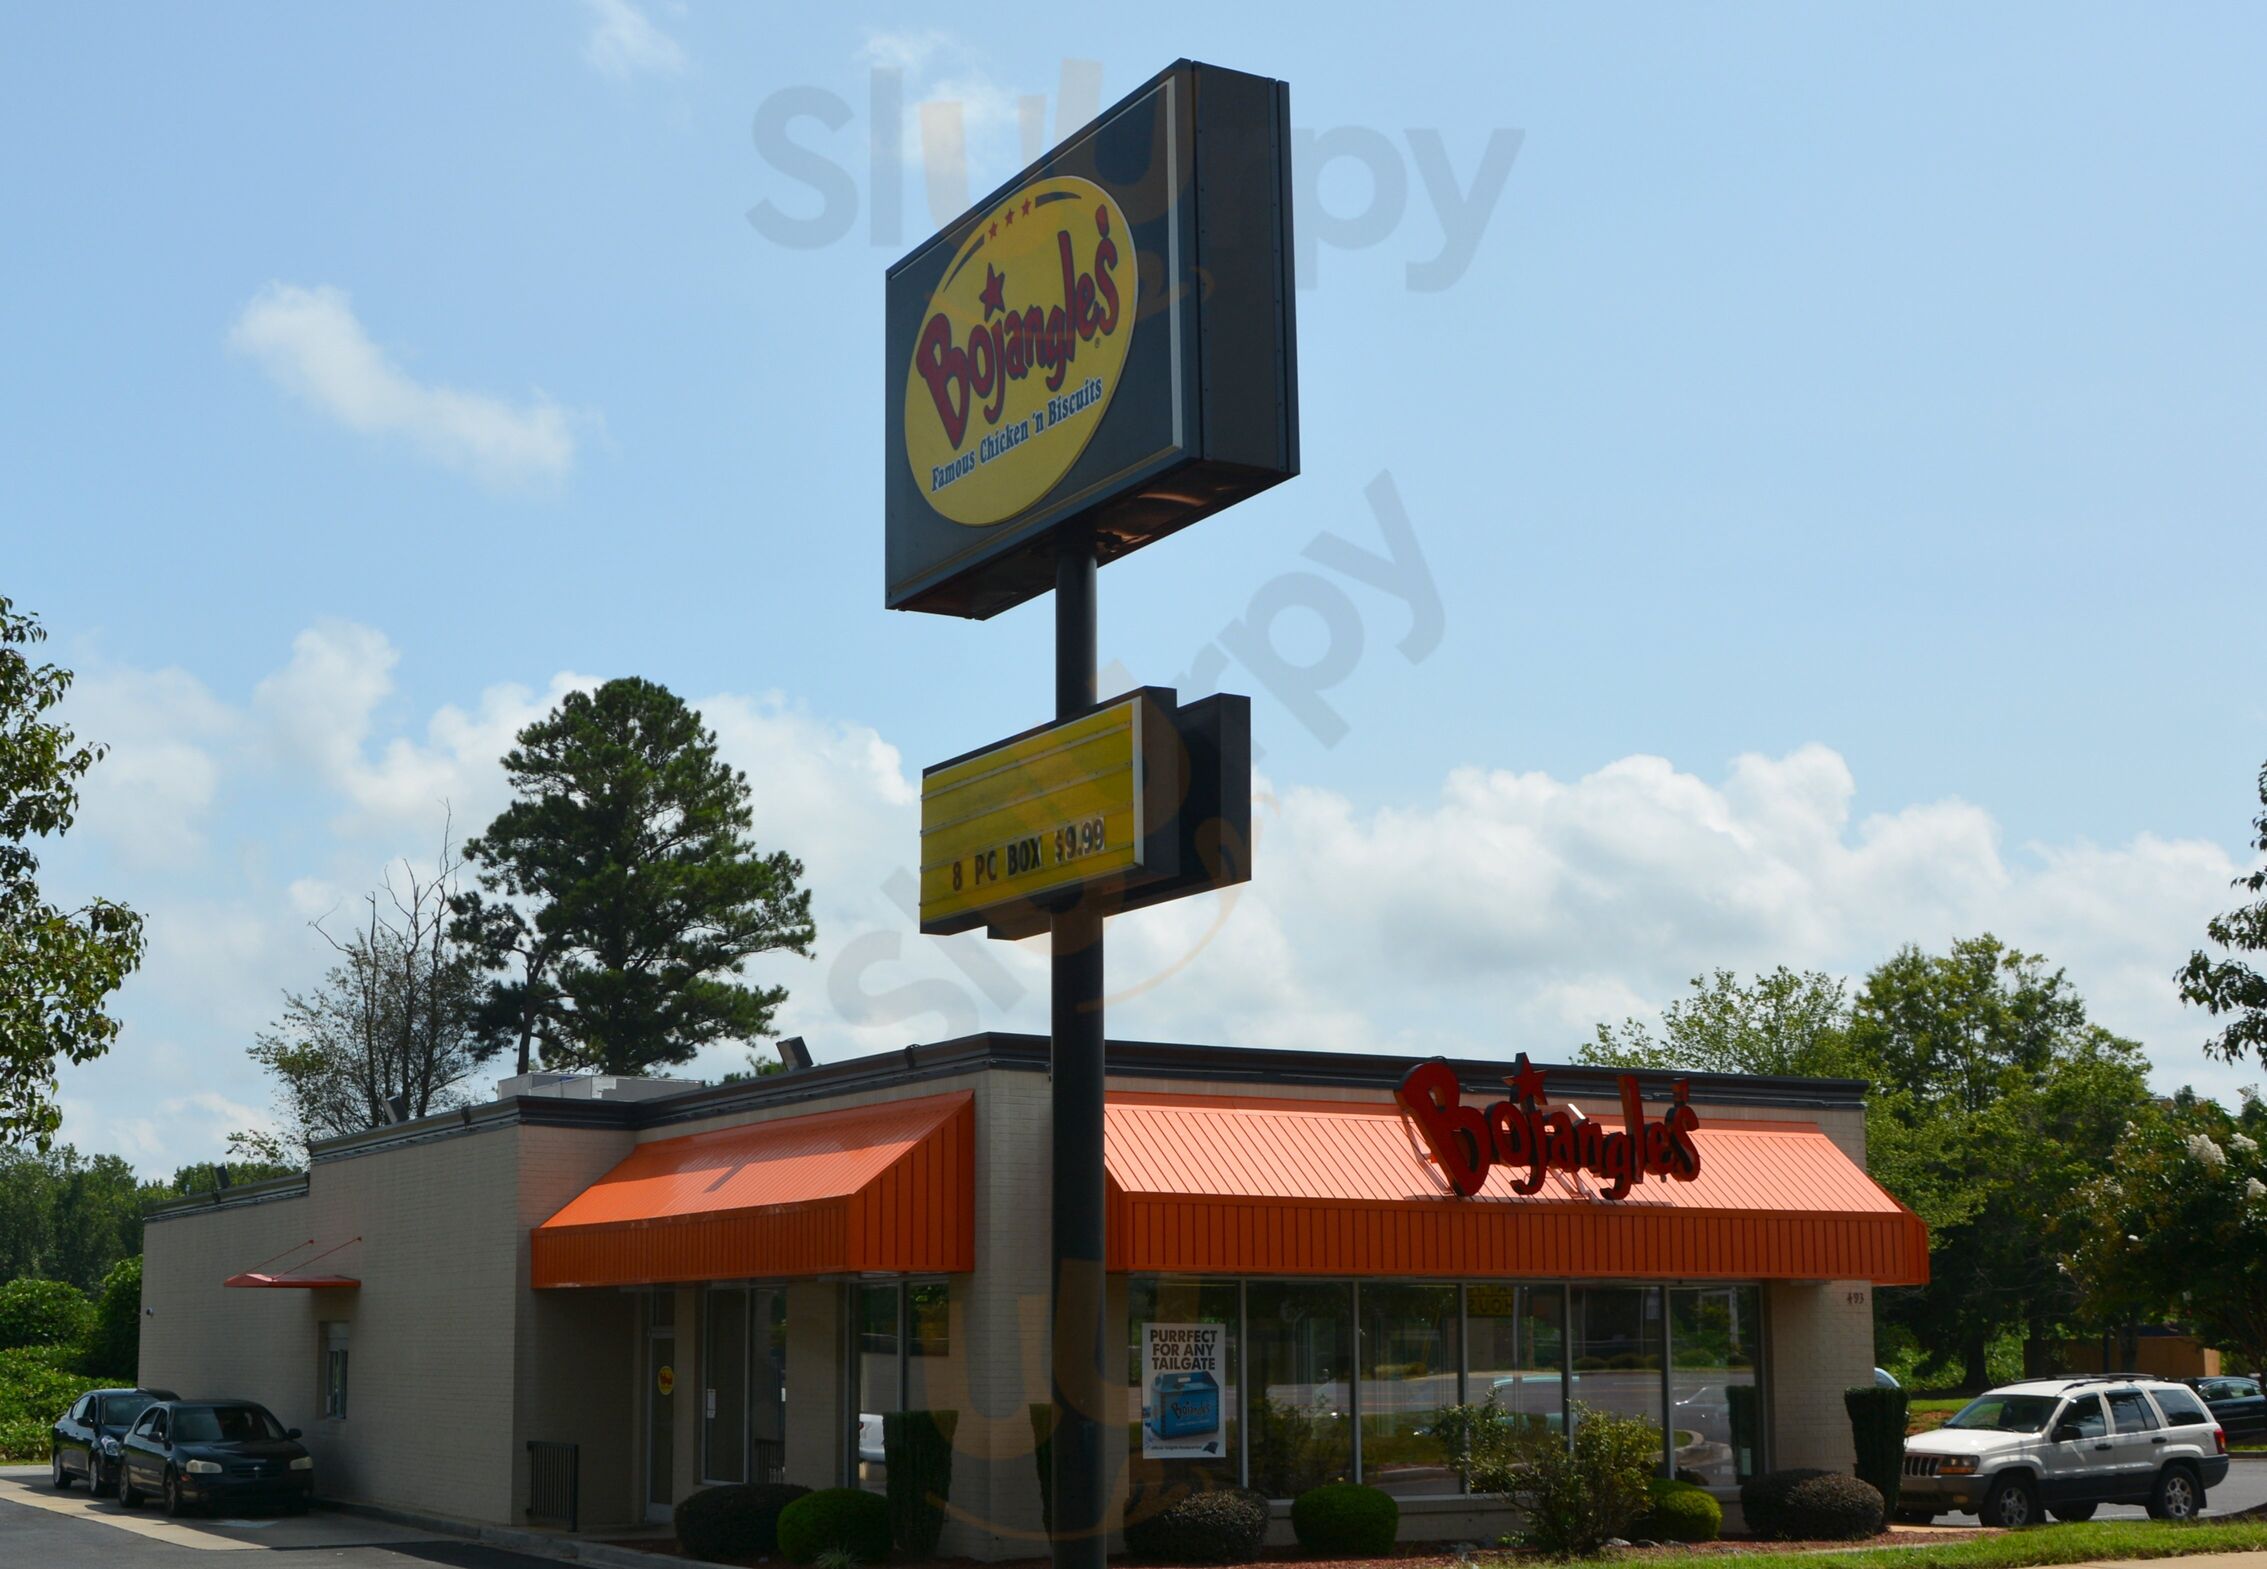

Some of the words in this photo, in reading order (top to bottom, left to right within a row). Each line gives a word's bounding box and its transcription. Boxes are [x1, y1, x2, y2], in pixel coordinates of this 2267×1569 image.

[931, 450, 976, 492] Famous
[979, 420, 1029, 463] Chicken
[1047, 378, 1103, 427] Biscuits
[952, 860, 963, 892] 8
[975, 850, 998, 885] PC
[1006, 835, 1042, 875] BOX
[1054, 817, 1105, 863] $9.99
[1150, 1329, 1218, 1343] PURRFECT
[1152, 1343, 1180, 1356] FOR
[1183, 1343, 1215, 1356] ANY
[1151, 1357, 1216, 1370] TAILGATE
